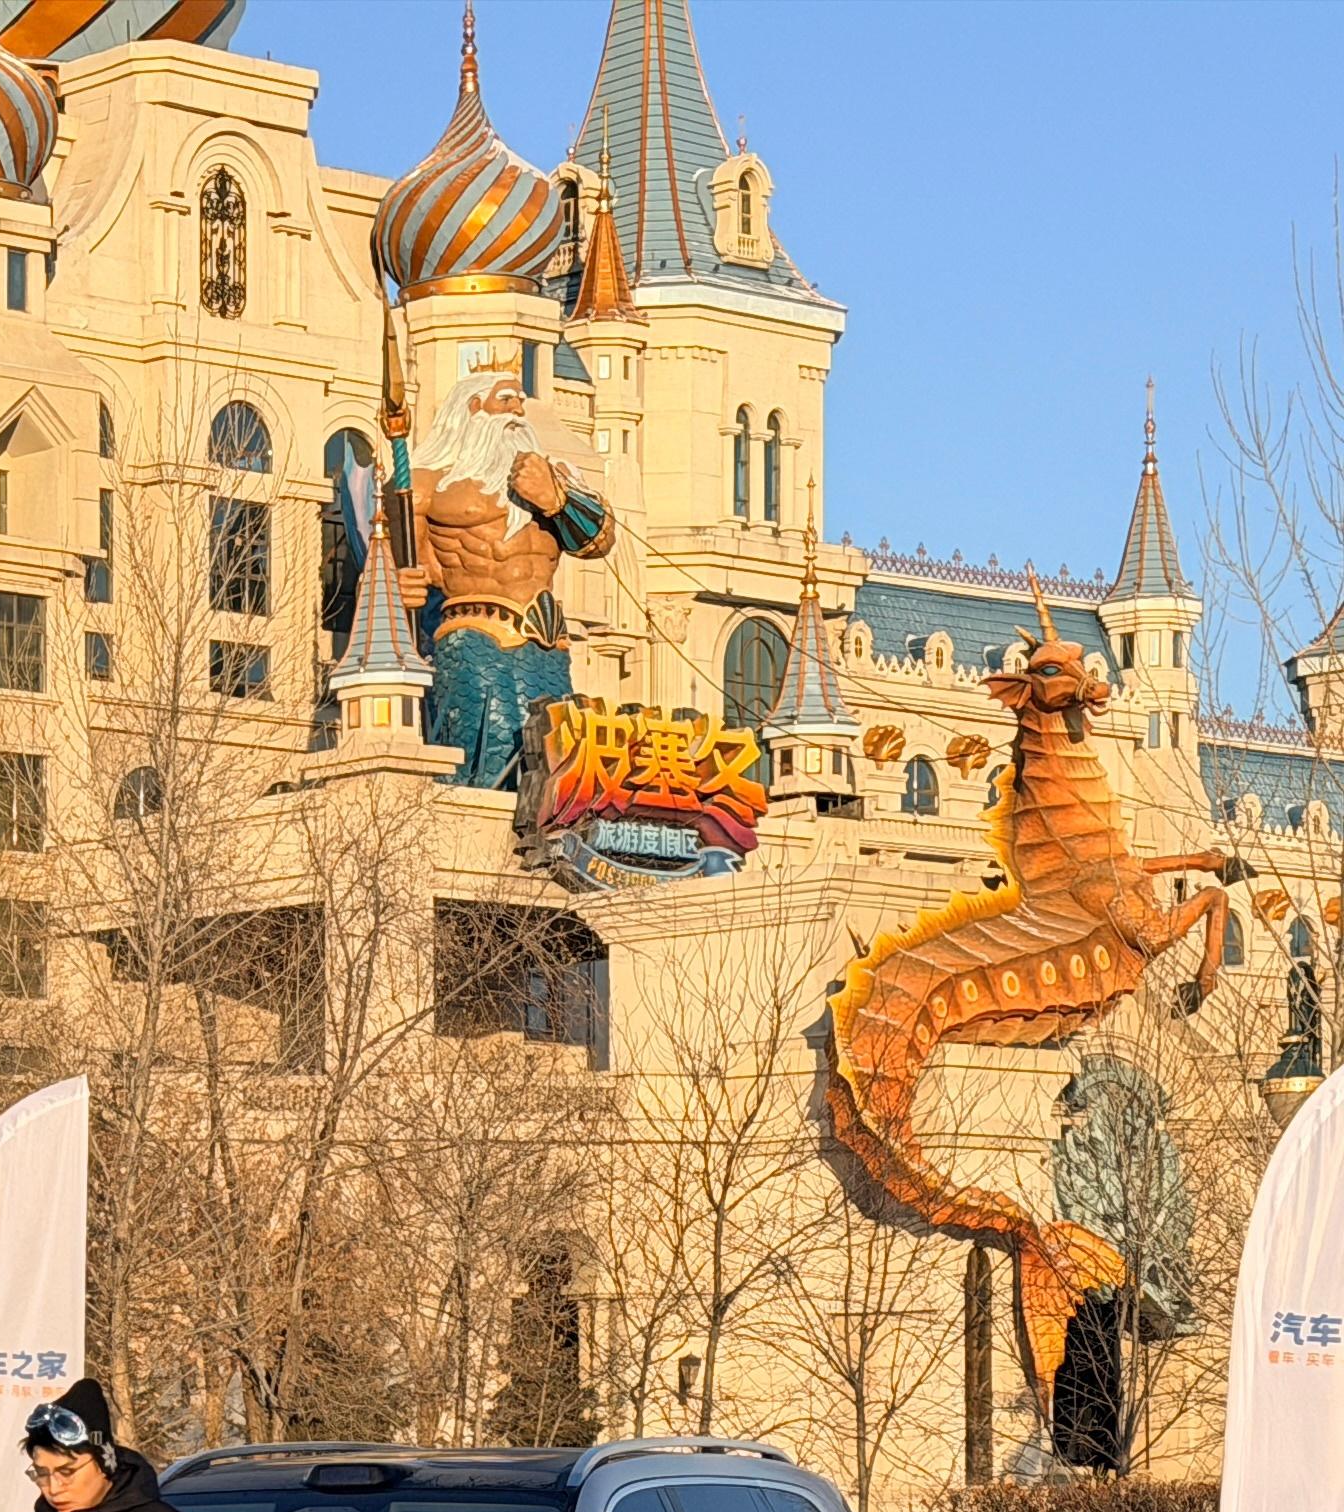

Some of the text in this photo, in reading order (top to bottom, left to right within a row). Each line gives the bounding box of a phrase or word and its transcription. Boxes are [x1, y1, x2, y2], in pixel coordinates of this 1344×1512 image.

[545, 702, 769, 849] 波塞冬
[595, 818, 702, 859] 旅游度假区
